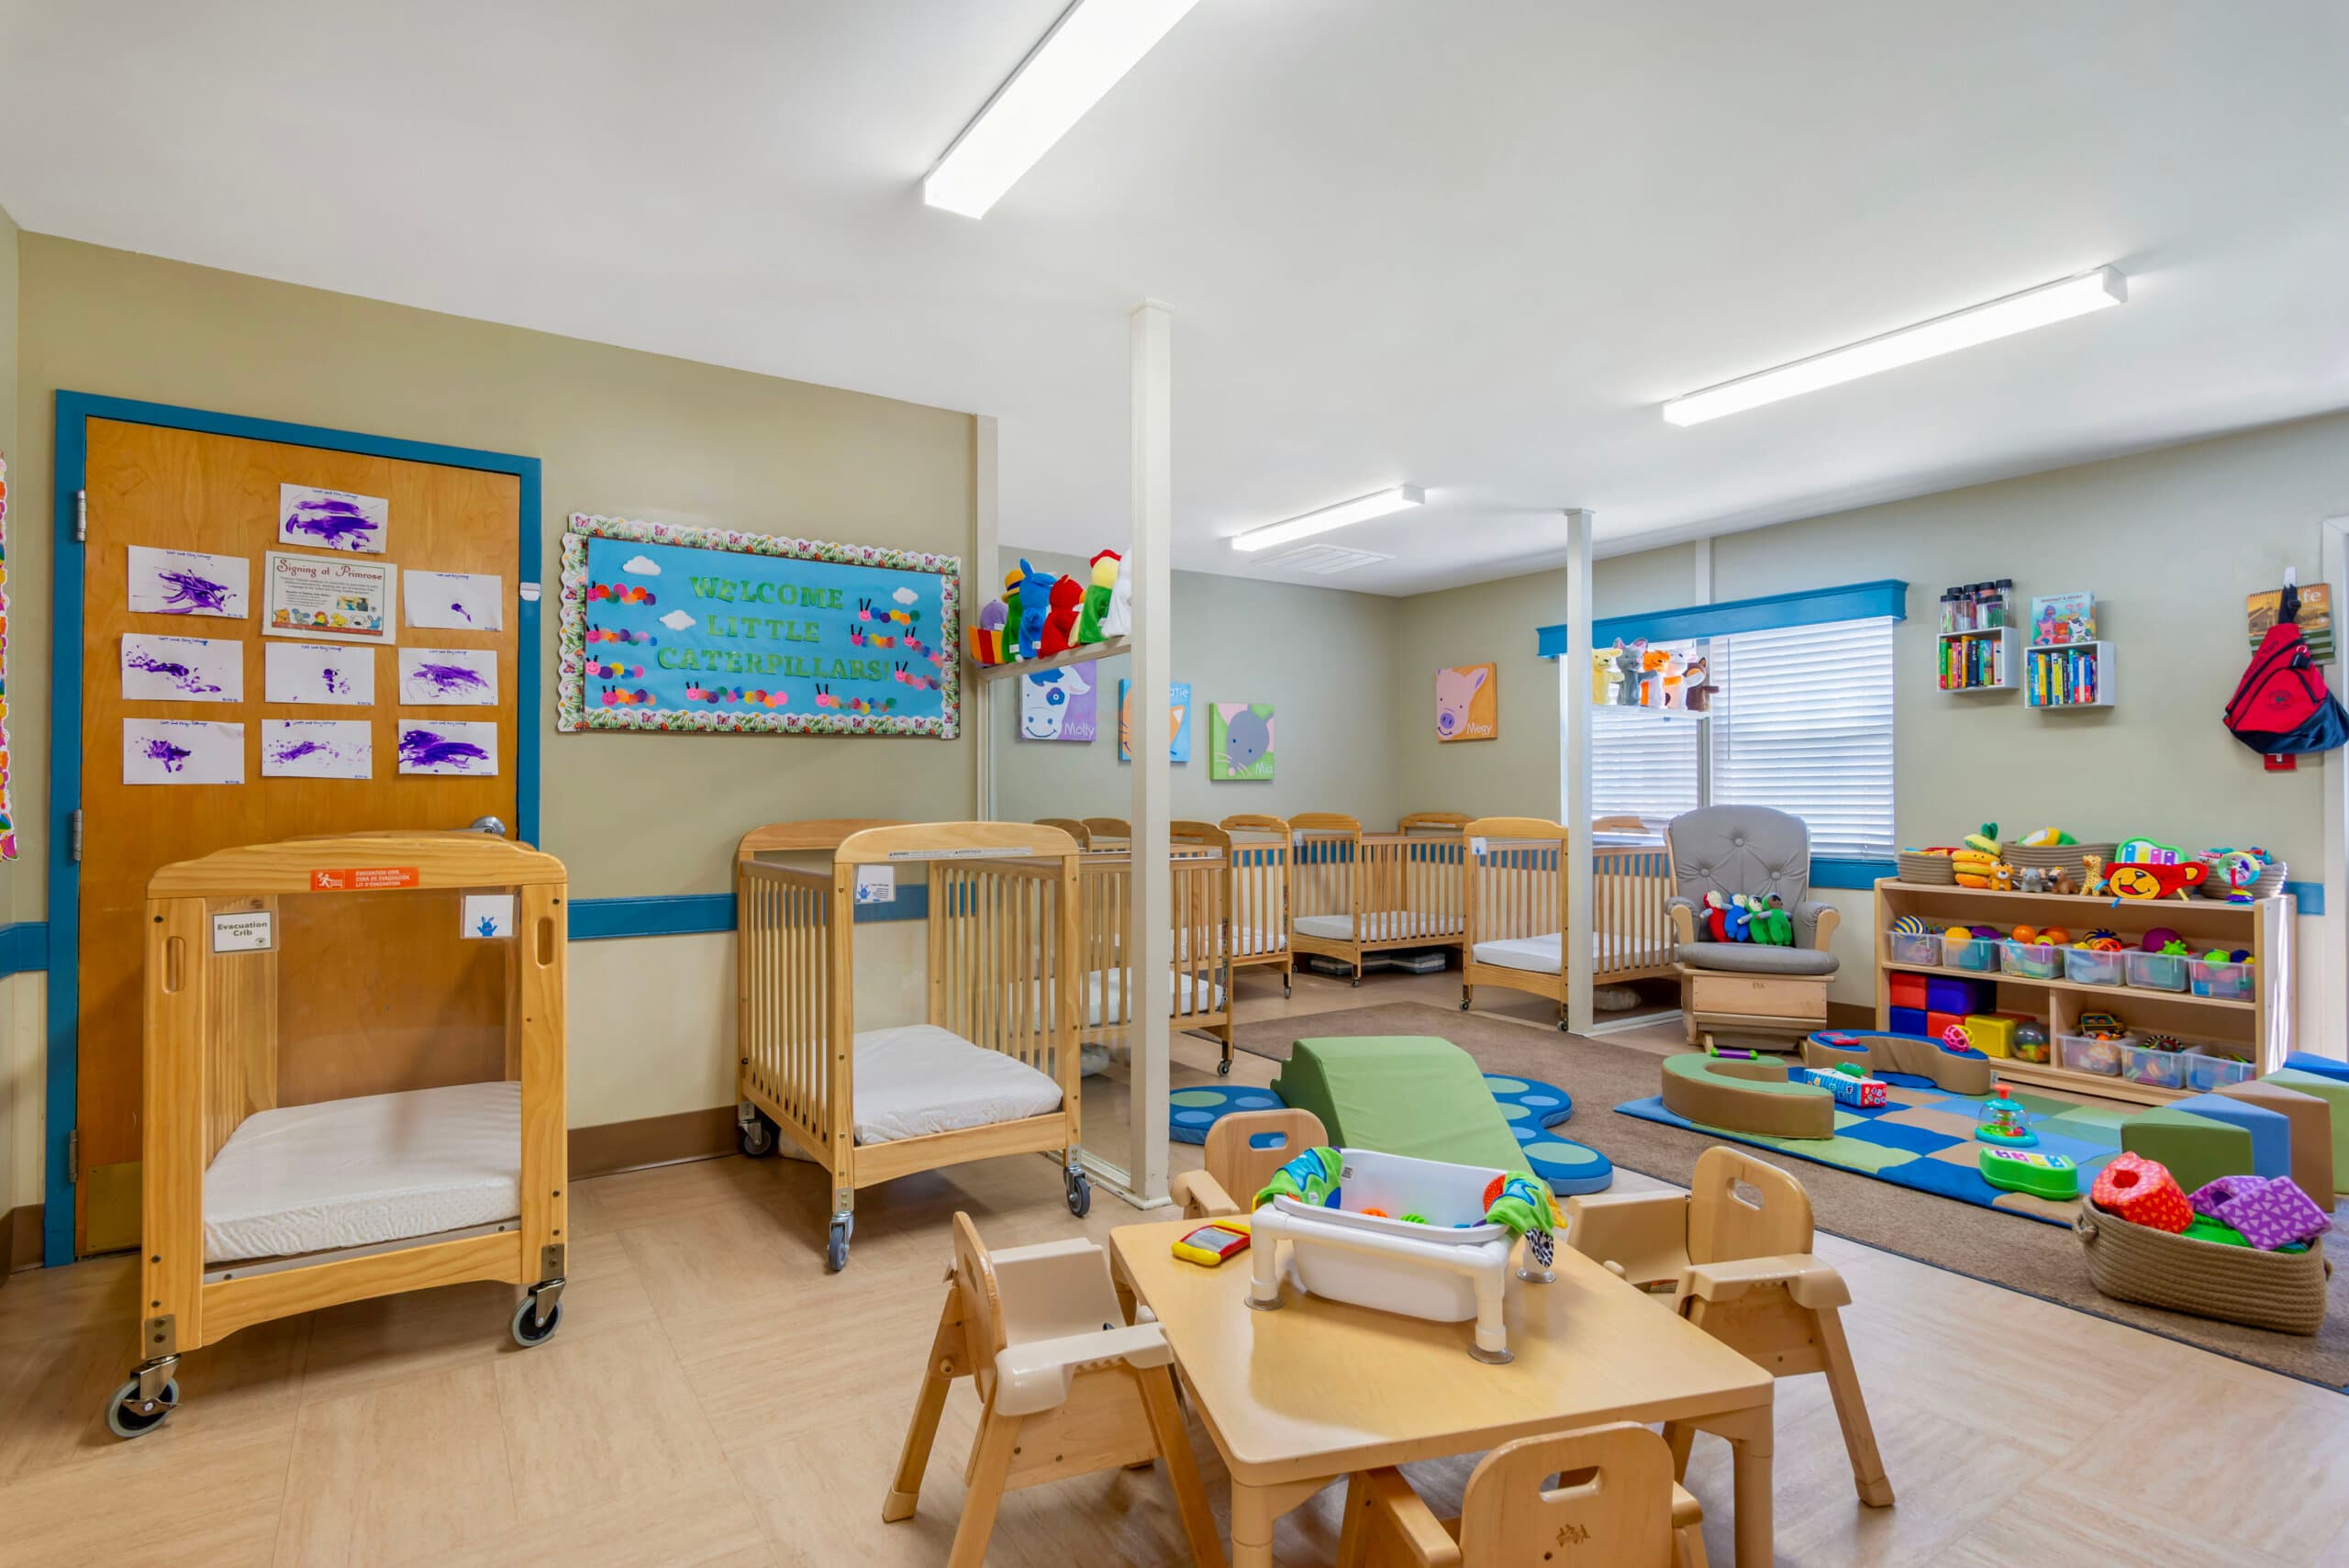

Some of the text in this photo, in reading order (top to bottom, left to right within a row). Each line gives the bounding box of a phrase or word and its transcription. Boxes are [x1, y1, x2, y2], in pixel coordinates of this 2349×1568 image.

[276, 559, 383, 581] Signing at Primrose
[689, 576, 843, 610] WELCOME
[707, 614, 821, 643] LITTLE
[657, 646, 890, 682] CATERPILLARS!
[1063, 720, 1095, 741] Molly
[1255, 762, 1274, 774] Mia
[217, 921, 268, 930] Evacuation
[233, 929, 253, 937] Crib
